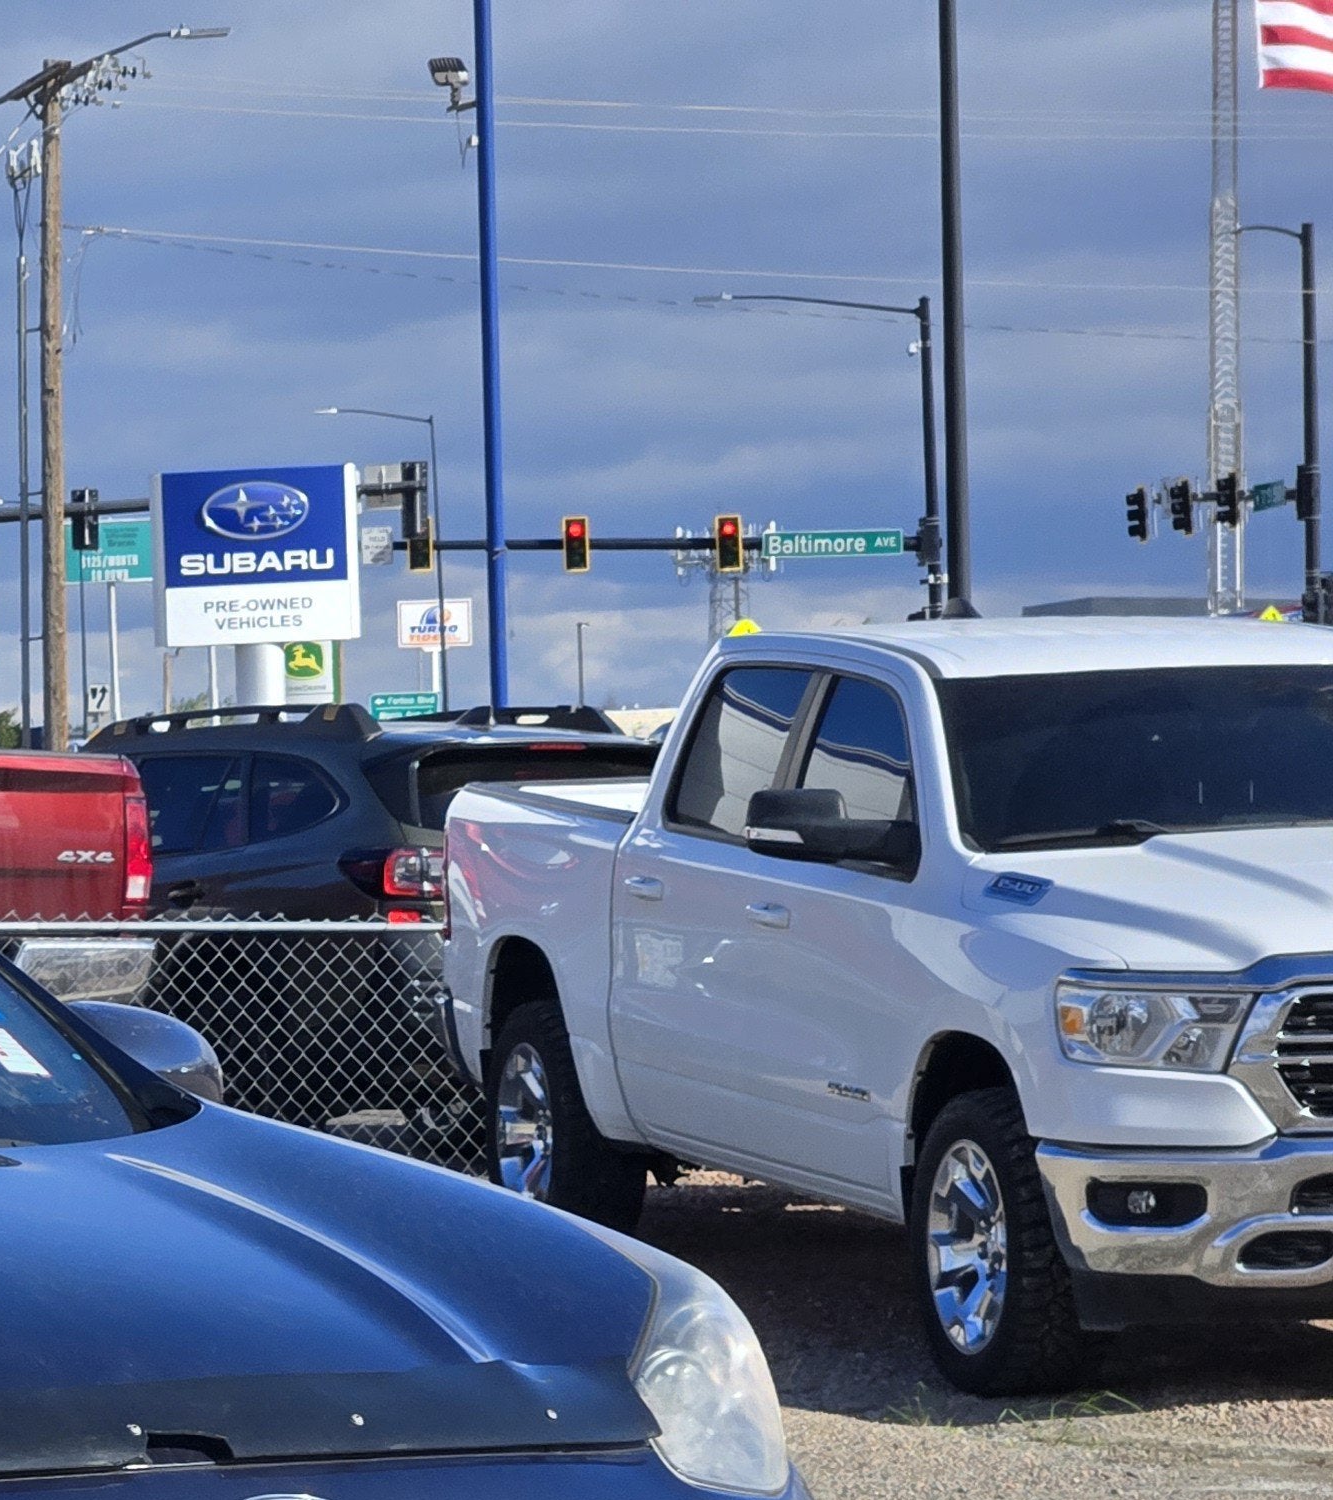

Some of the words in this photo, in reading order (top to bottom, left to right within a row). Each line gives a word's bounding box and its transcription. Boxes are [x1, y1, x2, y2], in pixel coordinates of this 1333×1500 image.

[768, 535, 866, 554] Baltimore
[874, 536, 896, 547] AVE
[180, 548, 334, 576] SUBARU
[203, 597, 314, 614] PRE-OWNED
[215, 614, 303, 631] VEHICLES
